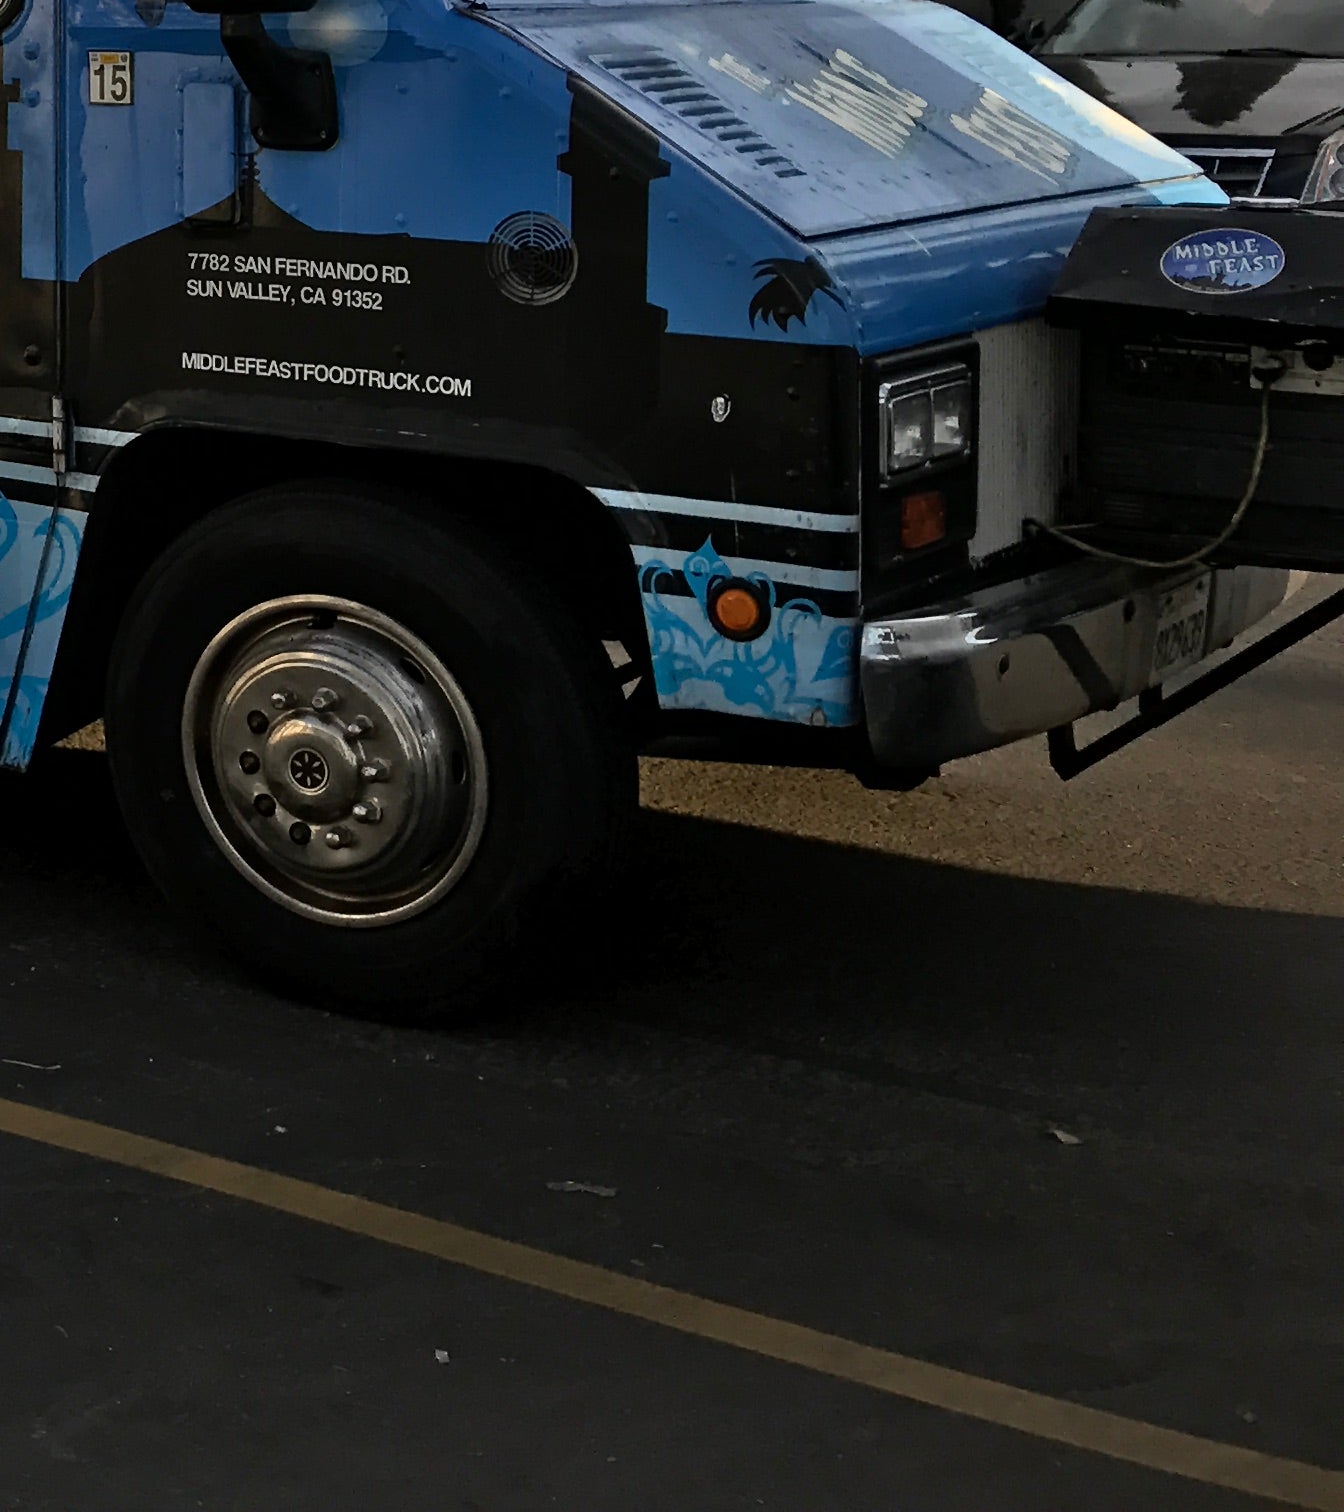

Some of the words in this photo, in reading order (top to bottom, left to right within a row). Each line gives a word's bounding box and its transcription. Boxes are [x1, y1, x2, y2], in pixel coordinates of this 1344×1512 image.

[92, 63, 128, 102] 15
[1174, 238, 1259, 260] MIDDLE
[1208, 254, 1279, 275] FEAST
[187, 252, 230, 272] 7782
[234, 256, 271, 274] SAN
[274, 257, 379, 283] FERNANDO
[381, 265, 411, 284] RD.
[186, 279, 223, 297] SUN
[226, 281, 296, 306] VALLEY,
[300, 286, 326, 305] CA
[331, 291, 384, 310] 91352
[181, 351, 473, 398] MIDDLEFEASTFOODTRUCK.COM
